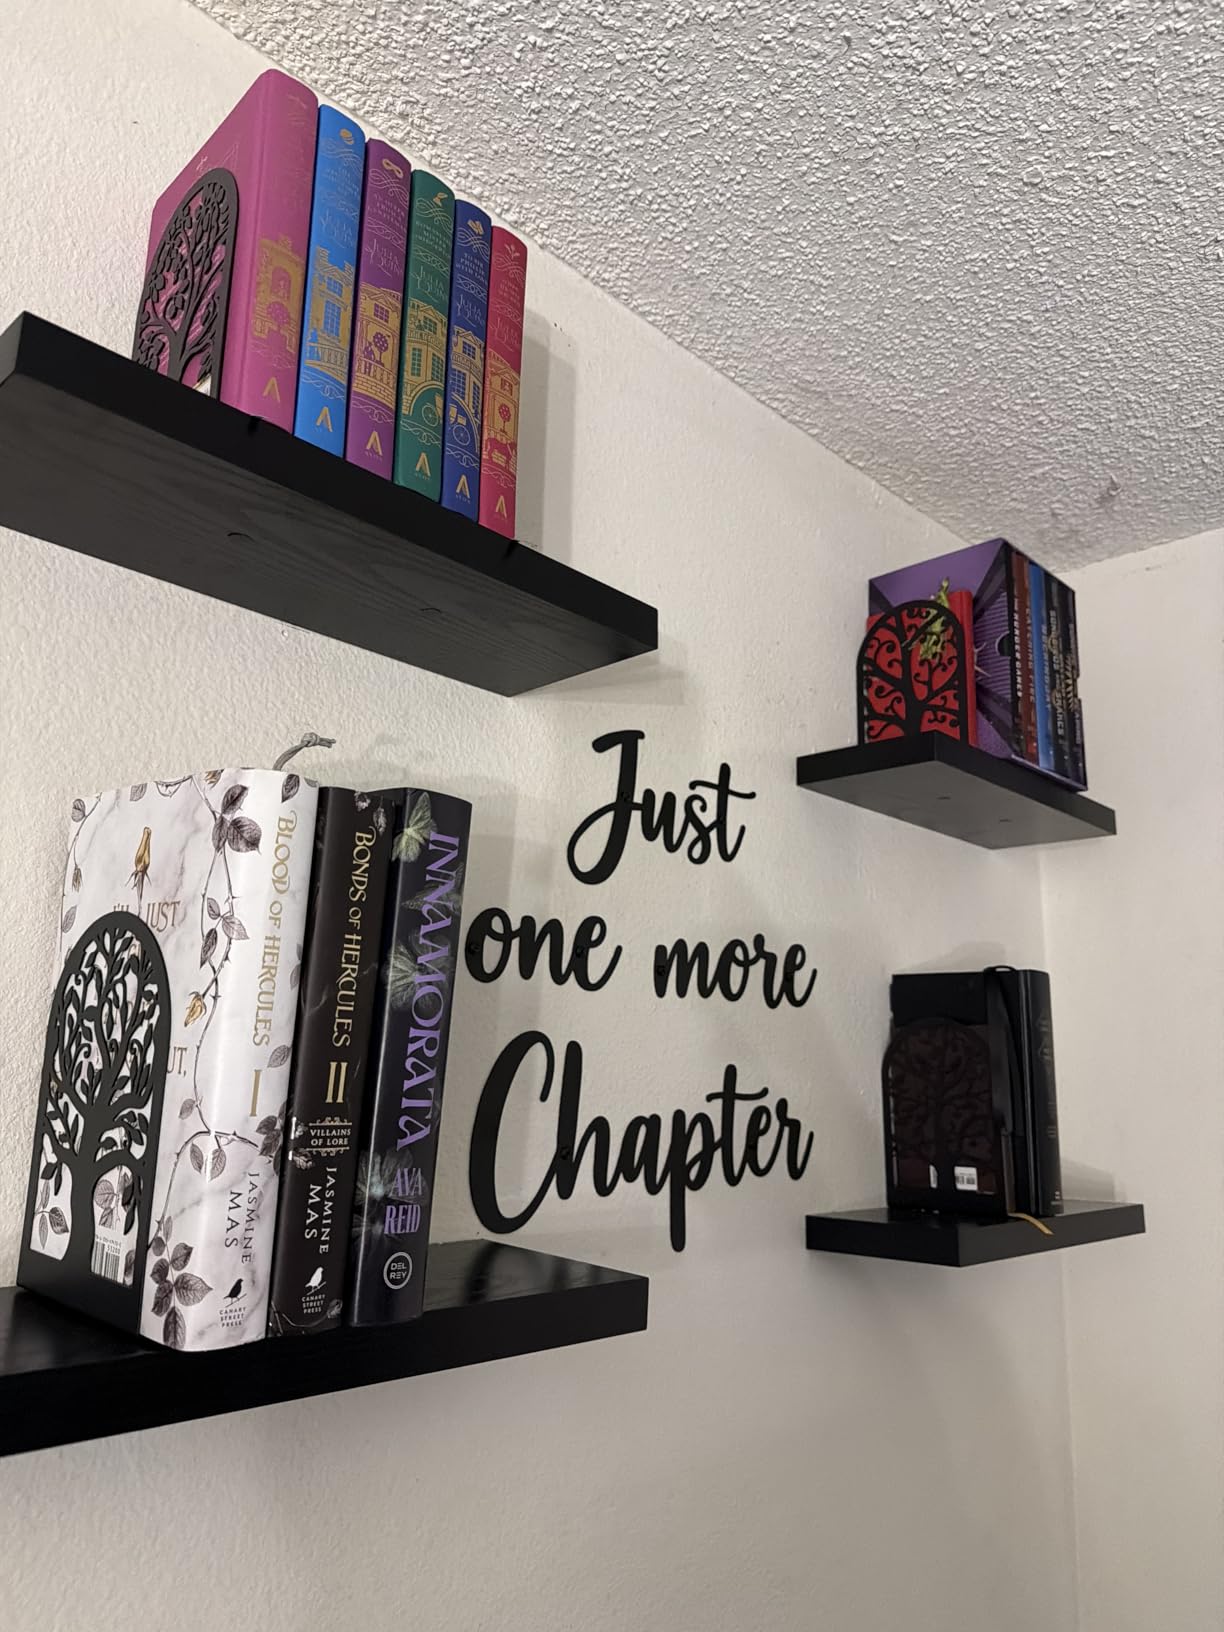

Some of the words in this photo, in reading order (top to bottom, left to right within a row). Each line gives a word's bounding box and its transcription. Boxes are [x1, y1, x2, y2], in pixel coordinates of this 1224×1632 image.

[567, 730, 756, 885] Just
[269, 810, 298, 895] BLOOD
[348, 826, 377, 902] BONDS
[146, 901, 180, 933] JUST
[268, 901, 283, 929] OF
[348, 907, 362, 931] OF
[465, 907, 622, 991] one
[653, 934, 817, 1009] more
[252, 935, 282, 1047] HERCULES
[332, 933, 362, 1048] HERCULES
[397, 831, 460, 1152] INNAMORATA
[325, 1062, 348, 1103] II
[309, 1128, 352, 1137] VILLAINS
[310, 1138, 323, 1146] OF
[326, 1137, 349, 1146] LORE
[469, 1030, 814, 1252] Chapter
[389, 1167, 422, 1197] AVA
[225, 1190, 244, 1249] MAS
[241, 1172, 260, 1264] JASMINE
[304, 1184, 323, 1240] MAS
[319, 1167, 338, 1254] JASMINE
[383, 1203, 422, 1235] REID
[389, 1271, 408, 1280] REY
[390, 1262, 408, 1271] DEL
[219, 1307, 247, 1315] CANARY
[301, 1294, 326, 1302] CANARY
[302, 1300, 324, 1308] STREET
[220, 1313, 245, 1322] STREET
[222, 1320, 243, 1328] PRESS
